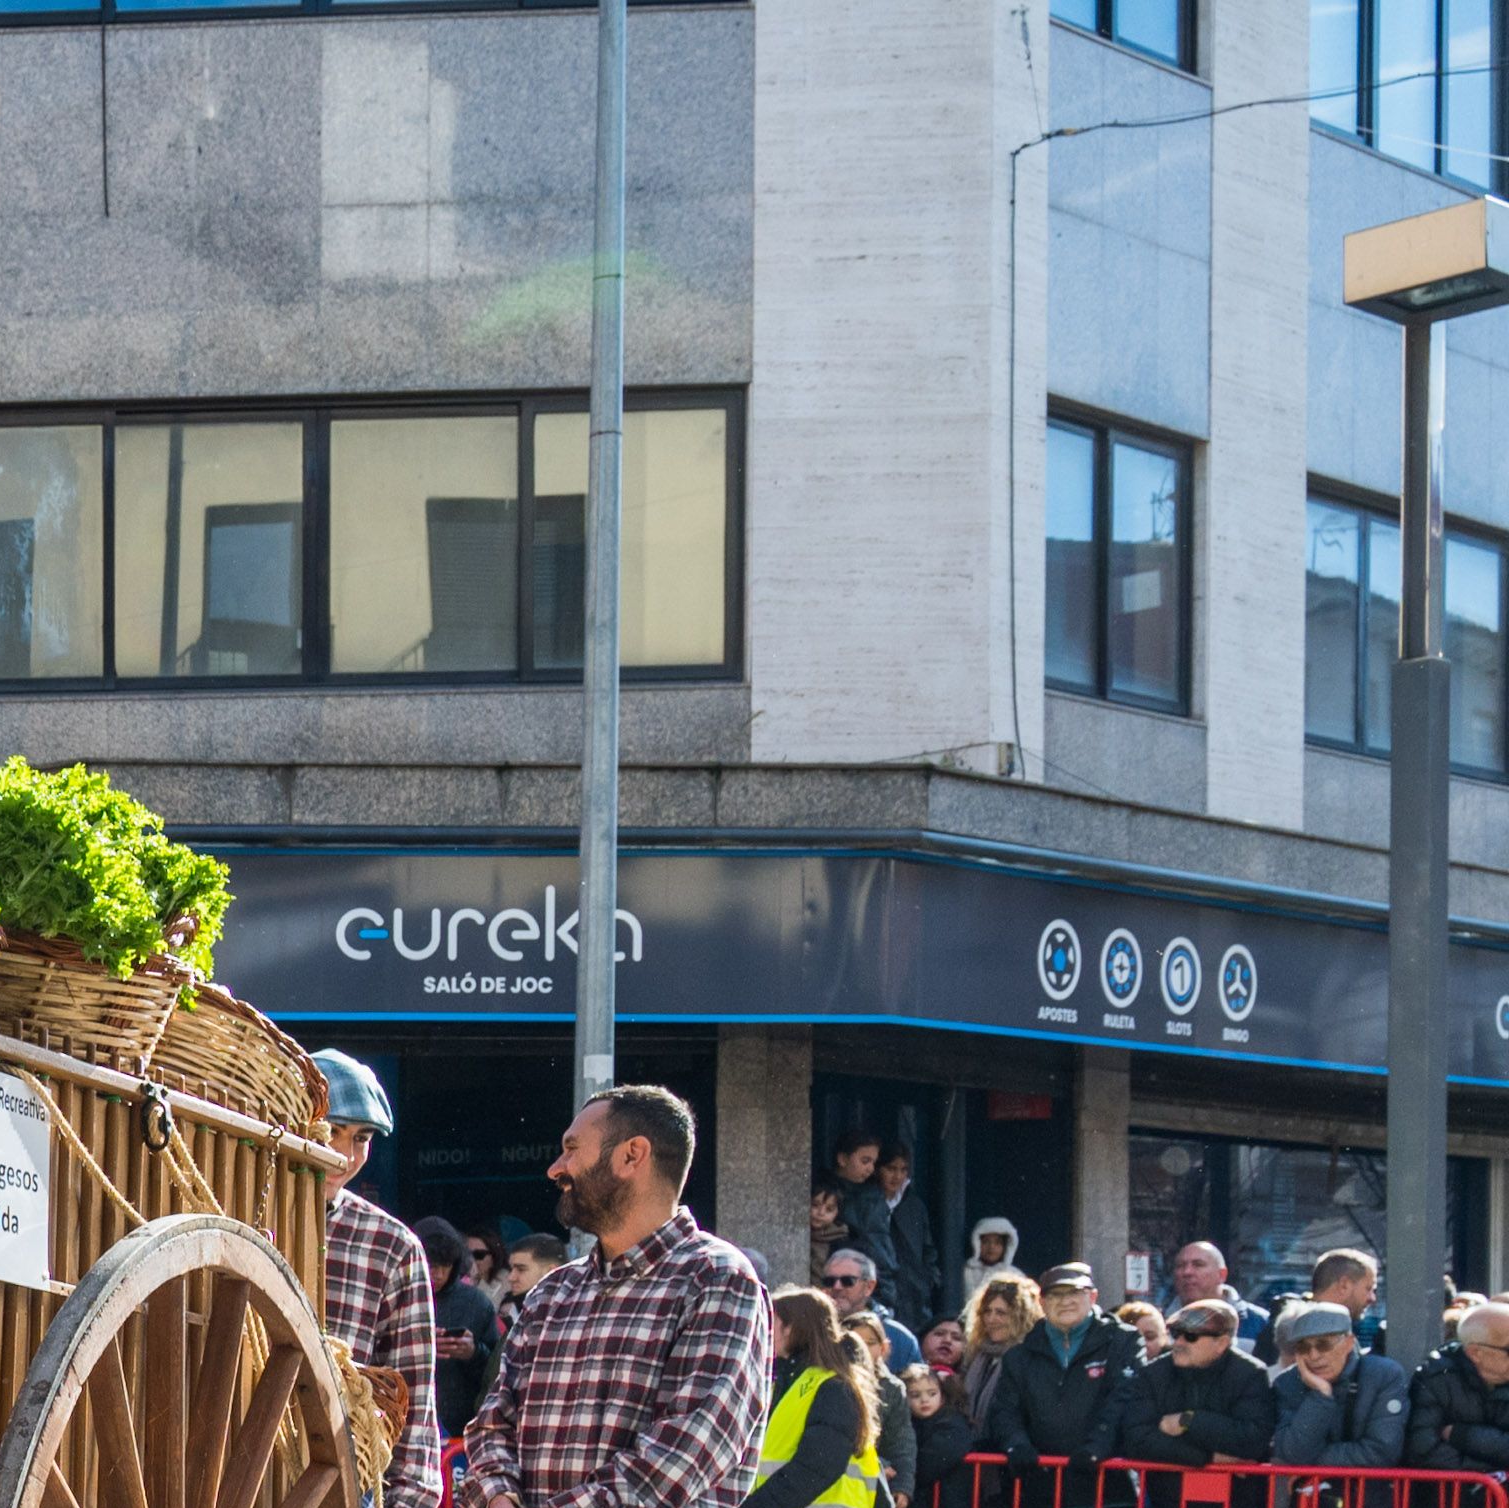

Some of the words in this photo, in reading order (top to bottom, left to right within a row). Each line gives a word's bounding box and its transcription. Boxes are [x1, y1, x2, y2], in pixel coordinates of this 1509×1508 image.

[423, 972, 477, 994] SALÓ
[481, 976, 506, 994] DE
[510, 976, 554, 994] JOC
[1038, 1006, 1078, 1024] APOSTES
[1103, 1013, 1136, 1030] RULETA
[1166, 1020, 1192, 1037] SLOTS
[1222, 1027, 1250, 1043] BINGO
